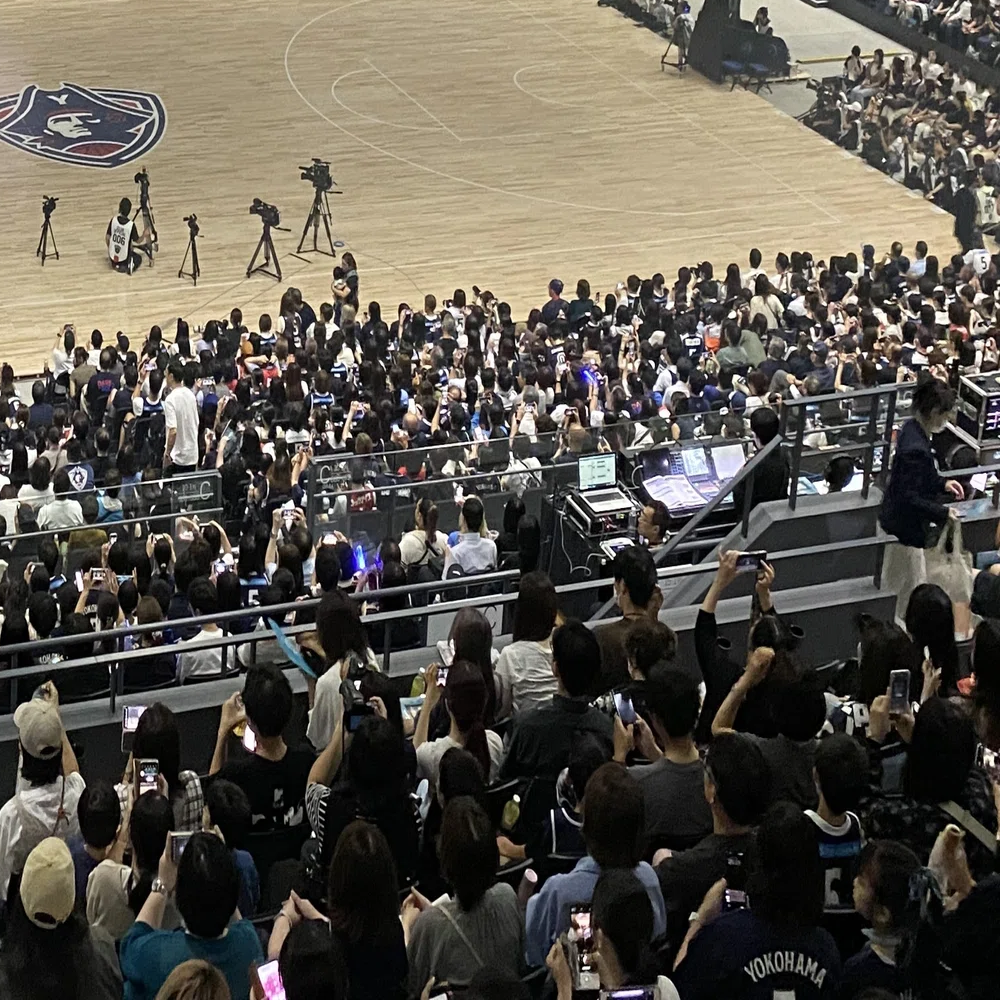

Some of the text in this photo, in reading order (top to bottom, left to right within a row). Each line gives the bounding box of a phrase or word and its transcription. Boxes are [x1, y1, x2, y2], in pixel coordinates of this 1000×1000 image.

[112, 234, 126, 246] 006
[980, 257, 988, 270] 5
[744, 951, 827, 989] YOKOHAMA
